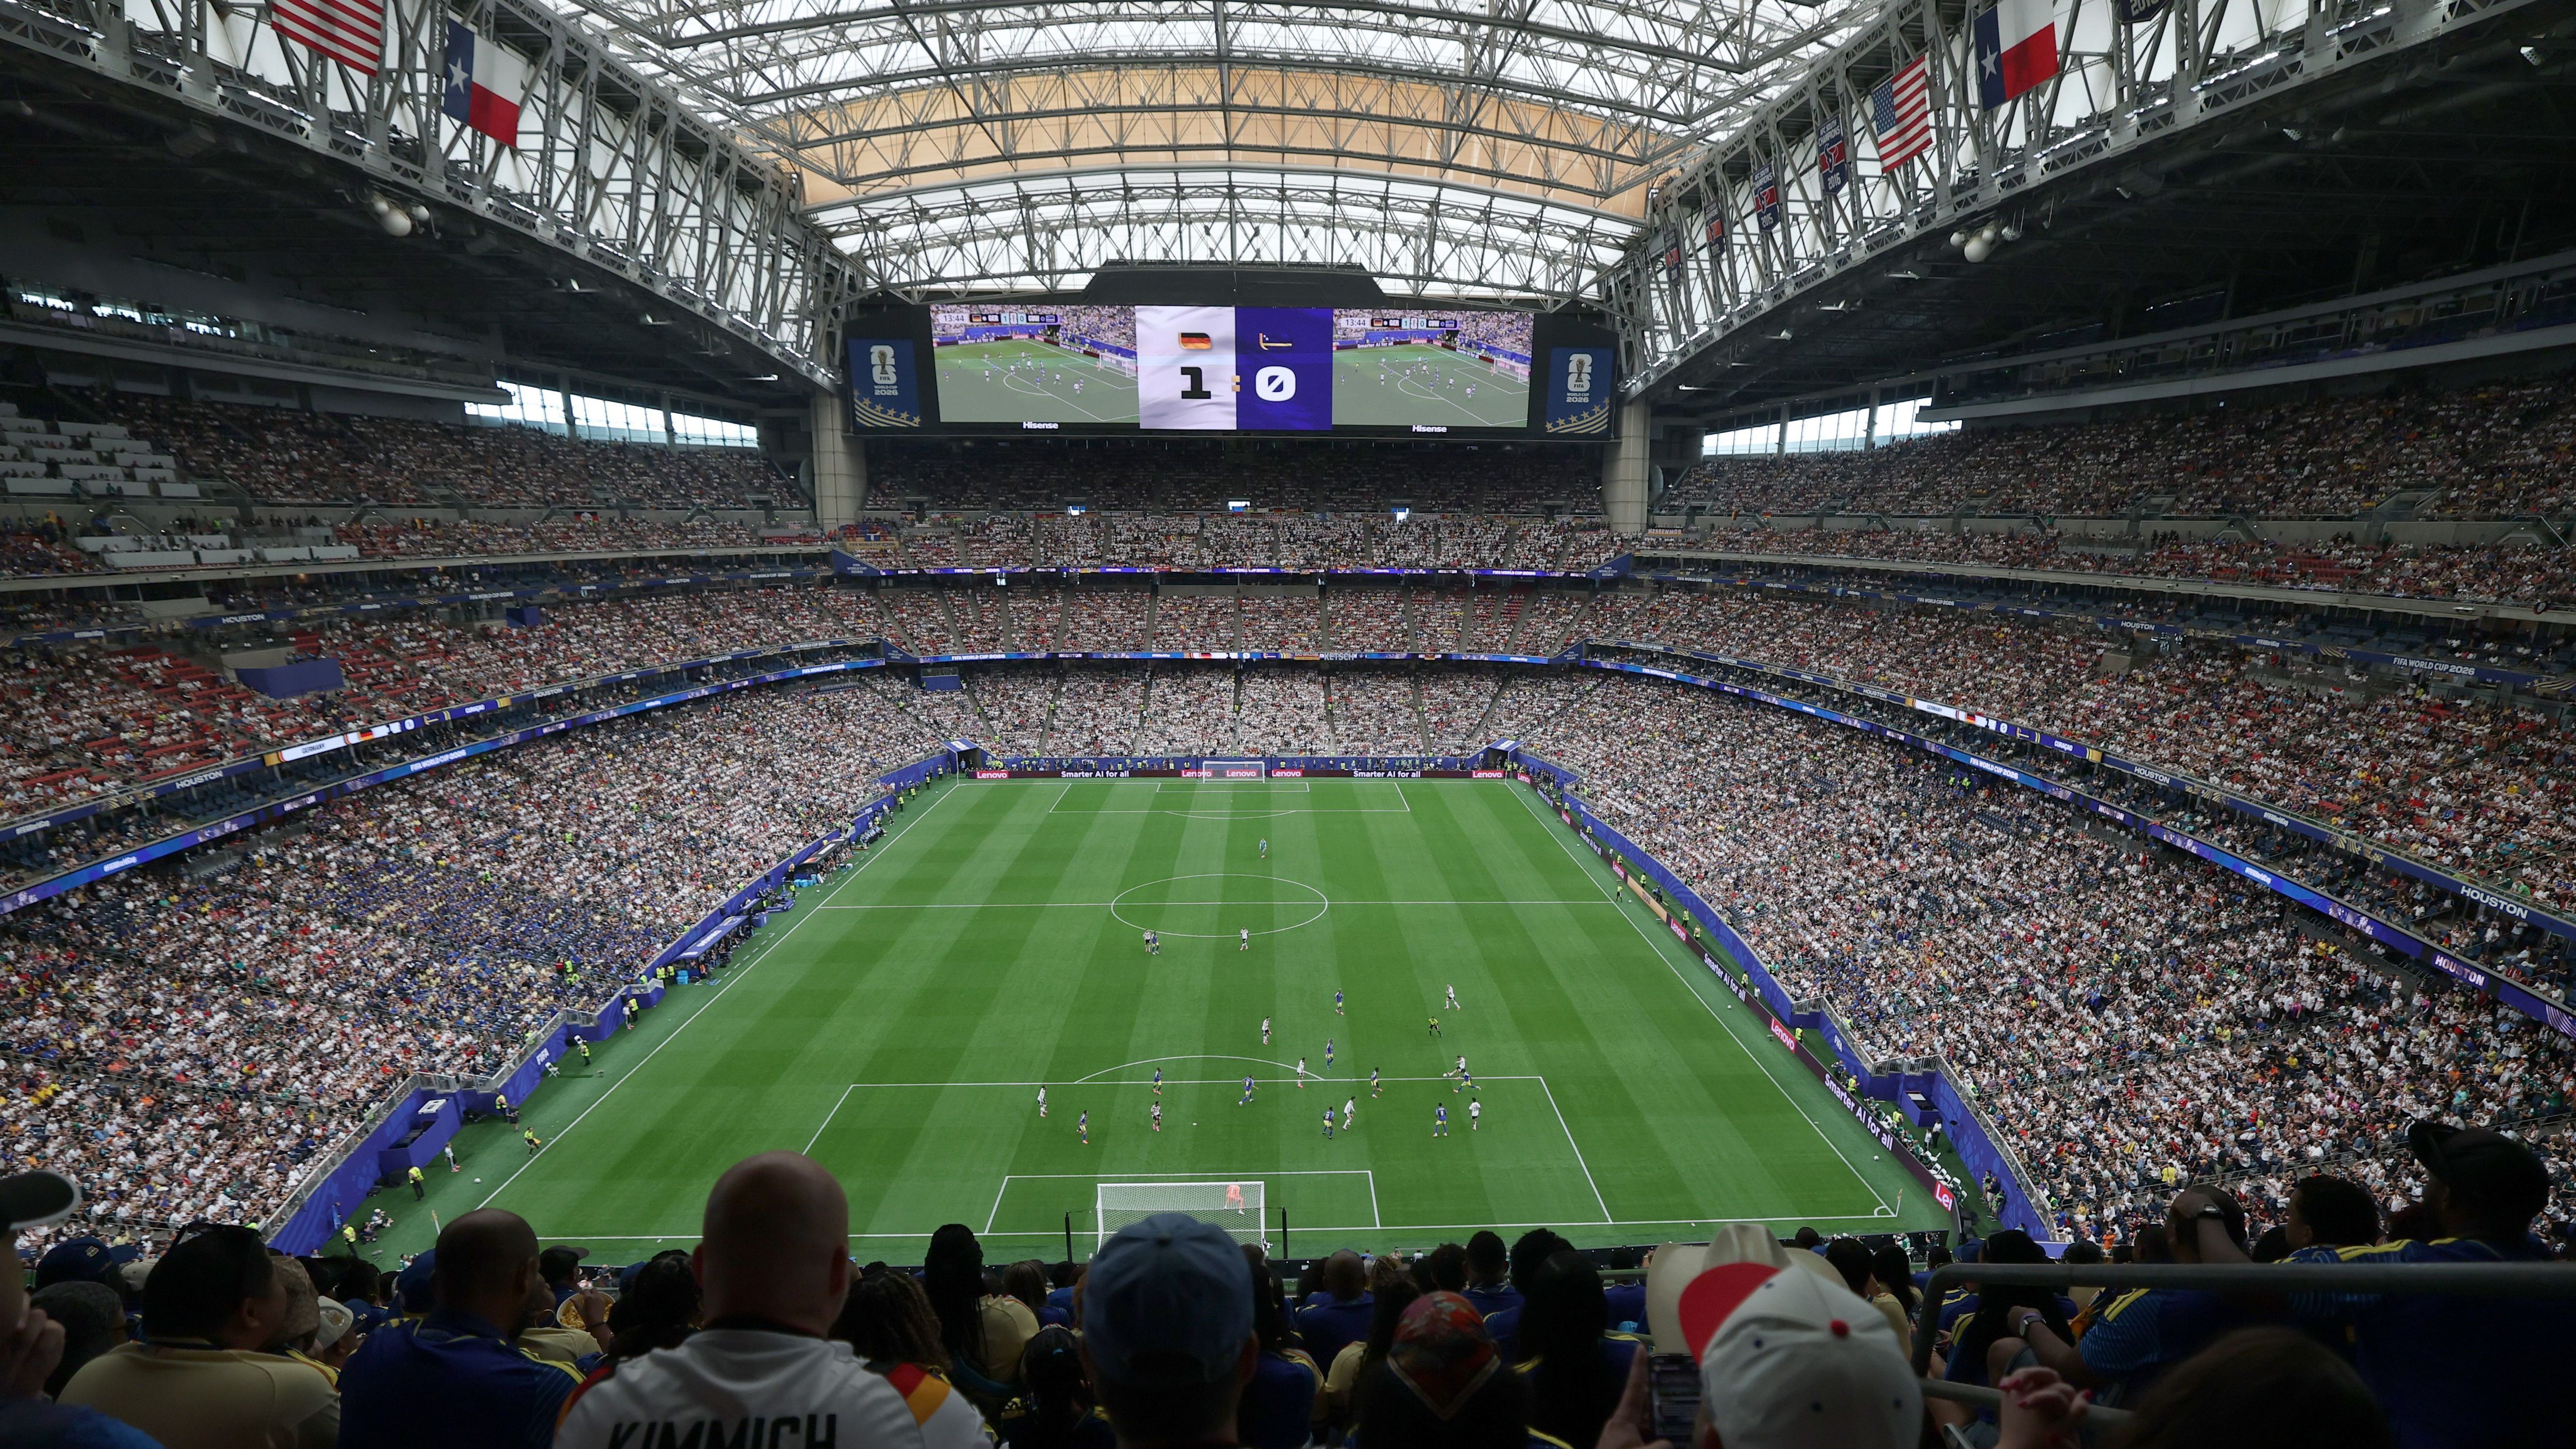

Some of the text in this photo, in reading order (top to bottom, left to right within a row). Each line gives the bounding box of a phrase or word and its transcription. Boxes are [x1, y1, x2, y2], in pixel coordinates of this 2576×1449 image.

[2131, 0, 2158, 17] 201
[1818, 125, 1840, 147] CHAMPIONS
[1828, 172, 1841, 190] 2016
[1761, 213, 1774, 228] 2015
[1181, 367, 1211, 399] 1
[1255, 366, 1296, 402] 0
[222, 614, 265, 624] HOUSTON
[2121, 621, 2155, 631] HOUSTON
[1324, 652, 1354, 661] KETSCH
[2393, 658, 2475, 675] FIFA WORLD CUP 2026
[533, 688, 563, 698] HOUSTON
[1863, 689, 1887, 698] HOUSTON
[1927, 705, 1942, 713] GERMANY
[1979, 760, 1994, 771] WORLD
[1994, 765, 2003, 774] CUP
[2003, 767, 2018, 779] 2026
[2134, 766, 2170, 784] HOUSTON
[175, 770, 224, 789] HOUSTON
[1561, 810, 1571, 825] Lenovo
[2098, 805, 2124, 821] HOUSTON
[1613, 860, 1624, 879] Lenovo
[1642, 891, 1651, 904] TEXAS
[2461, 886, 2528, 919] HOUSTON
[1670, 918, 1686, 941] Lenovo
[1704, 953, 1723, 979] Smarter
[1724, 972, 1729, 985] AI
[2435, 955, 2485, 986] HOUSTON
[1771, 1018, 1795, 1050] Lenovo
[536, 1048, 549, 1065] FIFA
[1825, 1074, 1893, 1151] Smarter AI for all
[608, 1414, 836, 1449] KIMMICH
